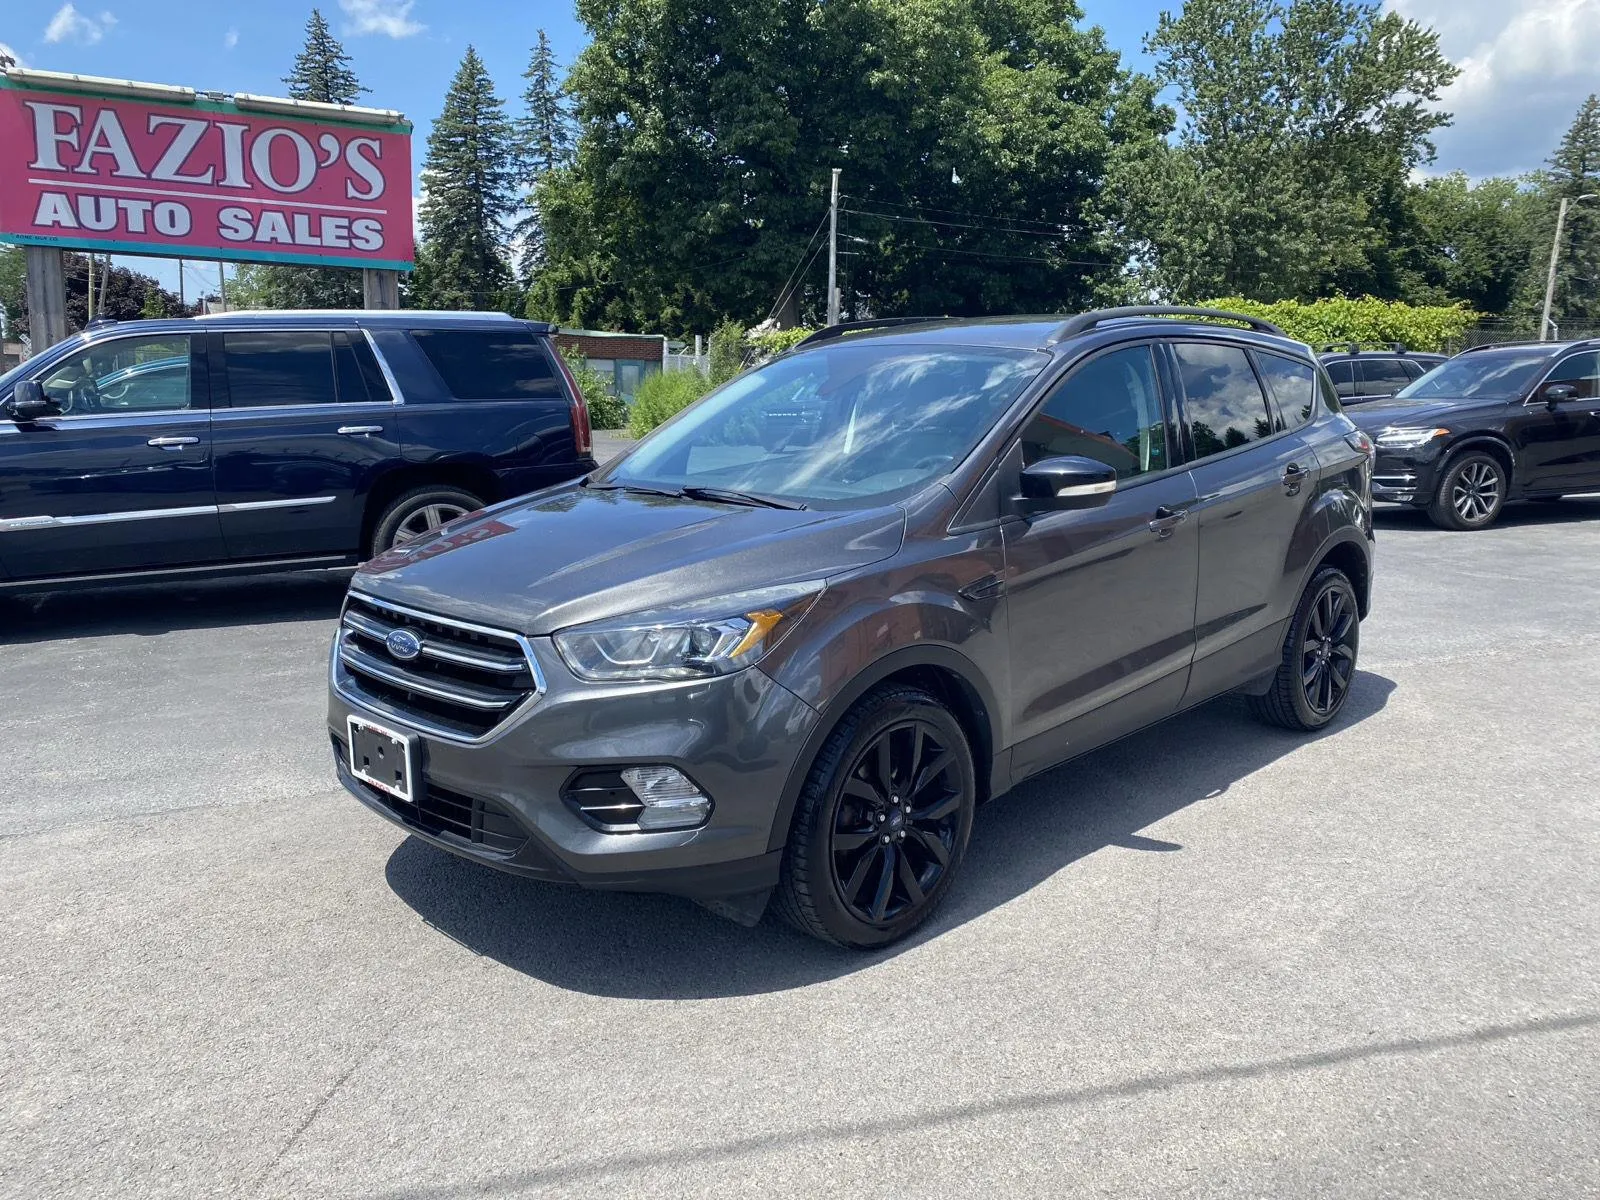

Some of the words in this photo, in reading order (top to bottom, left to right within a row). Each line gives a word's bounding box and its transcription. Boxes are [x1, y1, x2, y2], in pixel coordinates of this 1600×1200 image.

[24, 101, 387, 201] FAZIO'S
[32, 191, 192, 238] AUTO
[216, 206, 386, 251] SALES
